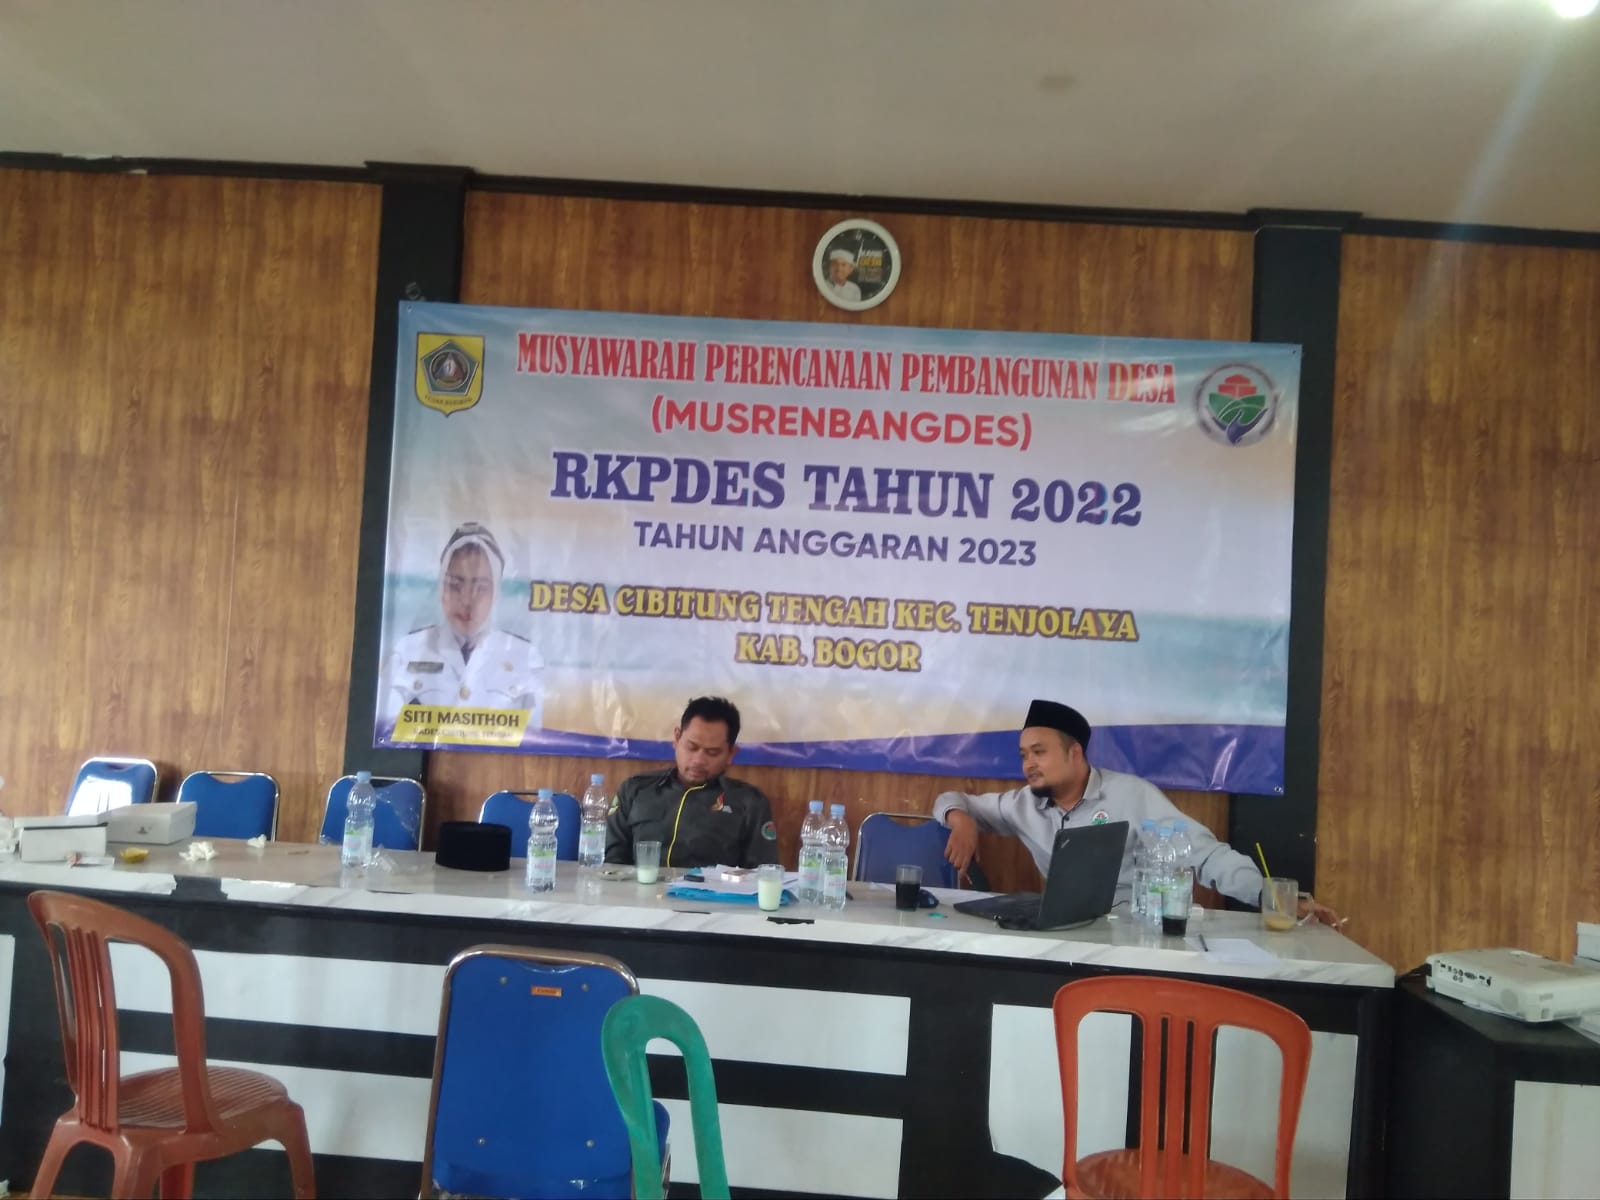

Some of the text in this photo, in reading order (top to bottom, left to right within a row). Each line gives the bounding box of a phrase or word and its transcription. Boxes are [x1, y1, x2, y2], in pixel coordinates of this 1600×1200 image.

[517, 331, 1177, 404] MUSYAWARAH PERENCANAAN PEMBANGUNAN DESA
[652, 396, 1032, 450] (MUSRENBANGDES)
[551, 452, 1142, 527] RKPDES TAHUN 2022
[634, 522, 1037, 566] TAHUN ANGGARAN 2023
[529, 580, 1139, 642] DESA CIBITUNG TENGAH KEC. TENJOLAYA
[734, 632, 922, 672] KAB. BOGOR
[403, 709, 520, 728] SITI MASITHOH
